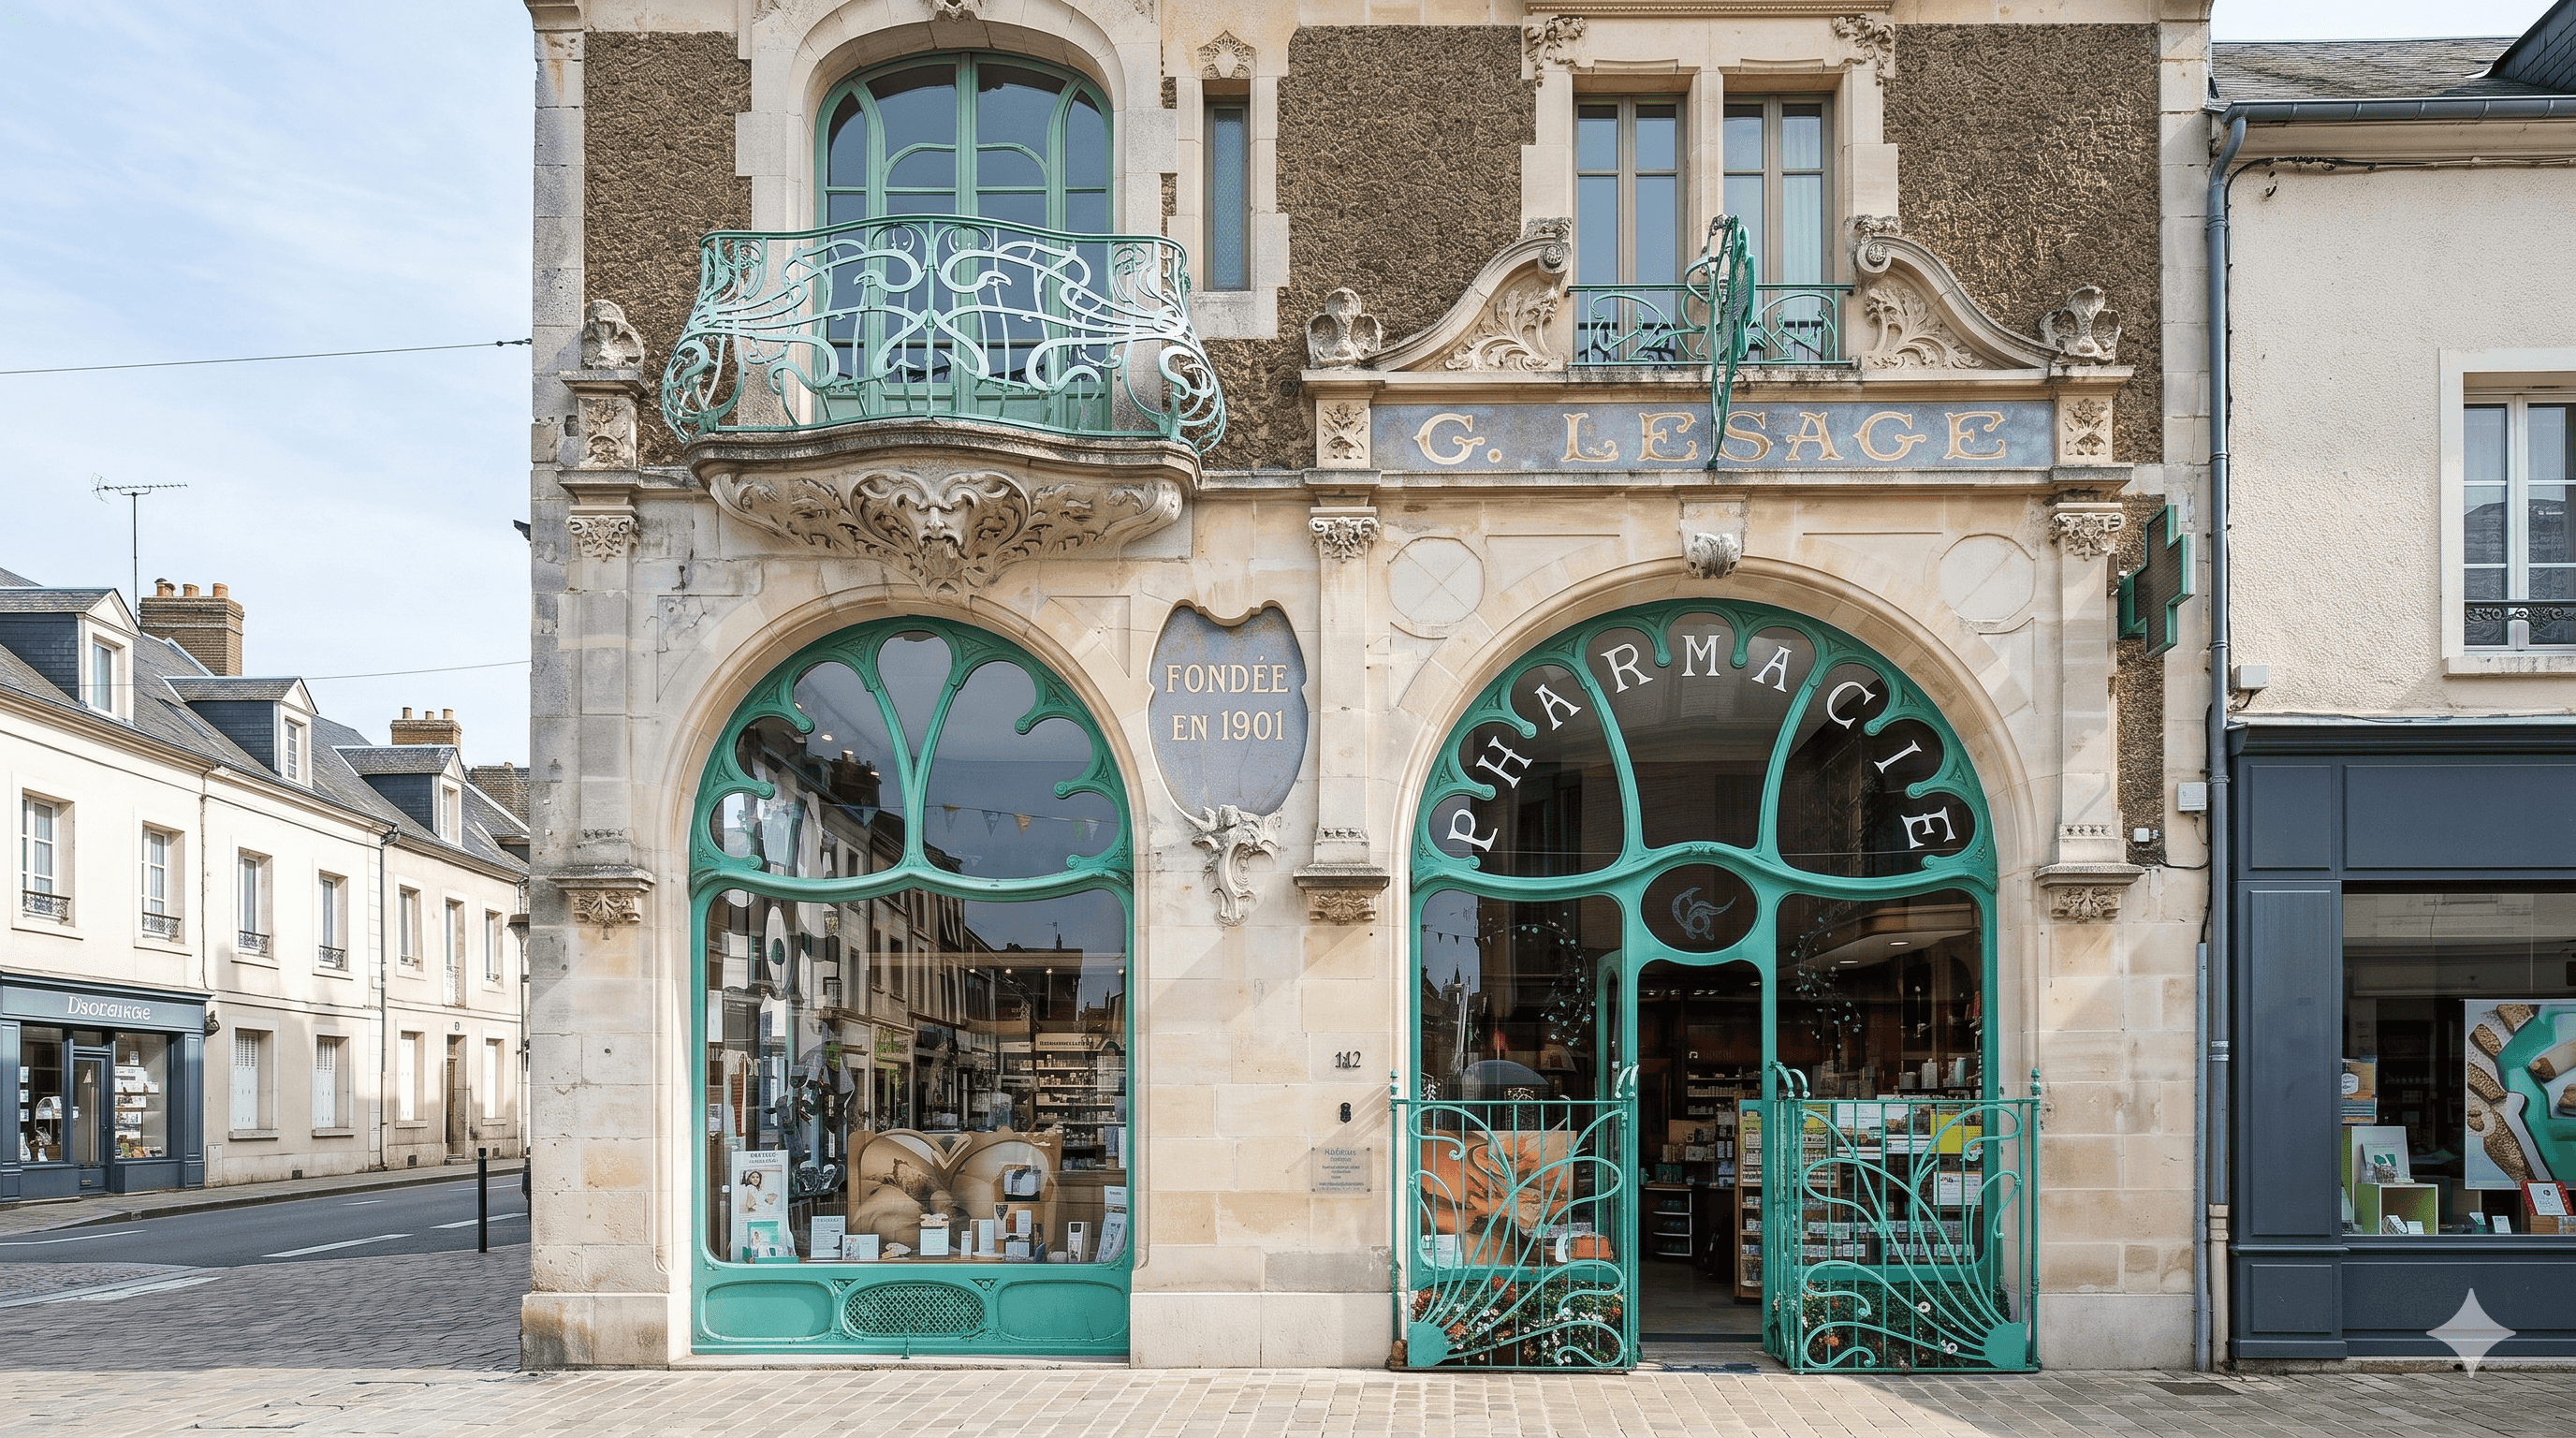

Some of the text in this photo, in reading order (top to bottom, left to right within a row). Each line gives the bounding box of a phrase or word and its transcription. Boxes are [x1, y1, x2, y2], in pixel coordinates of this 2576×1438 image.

[1412, 410, 2007, 465] G. LESAGE
[1164, 654, 1289, 694] FONDÉE
[1171, 710, 1284, 741] EN 1901
[1446, 634, 1957, 852] PHARMACIE
